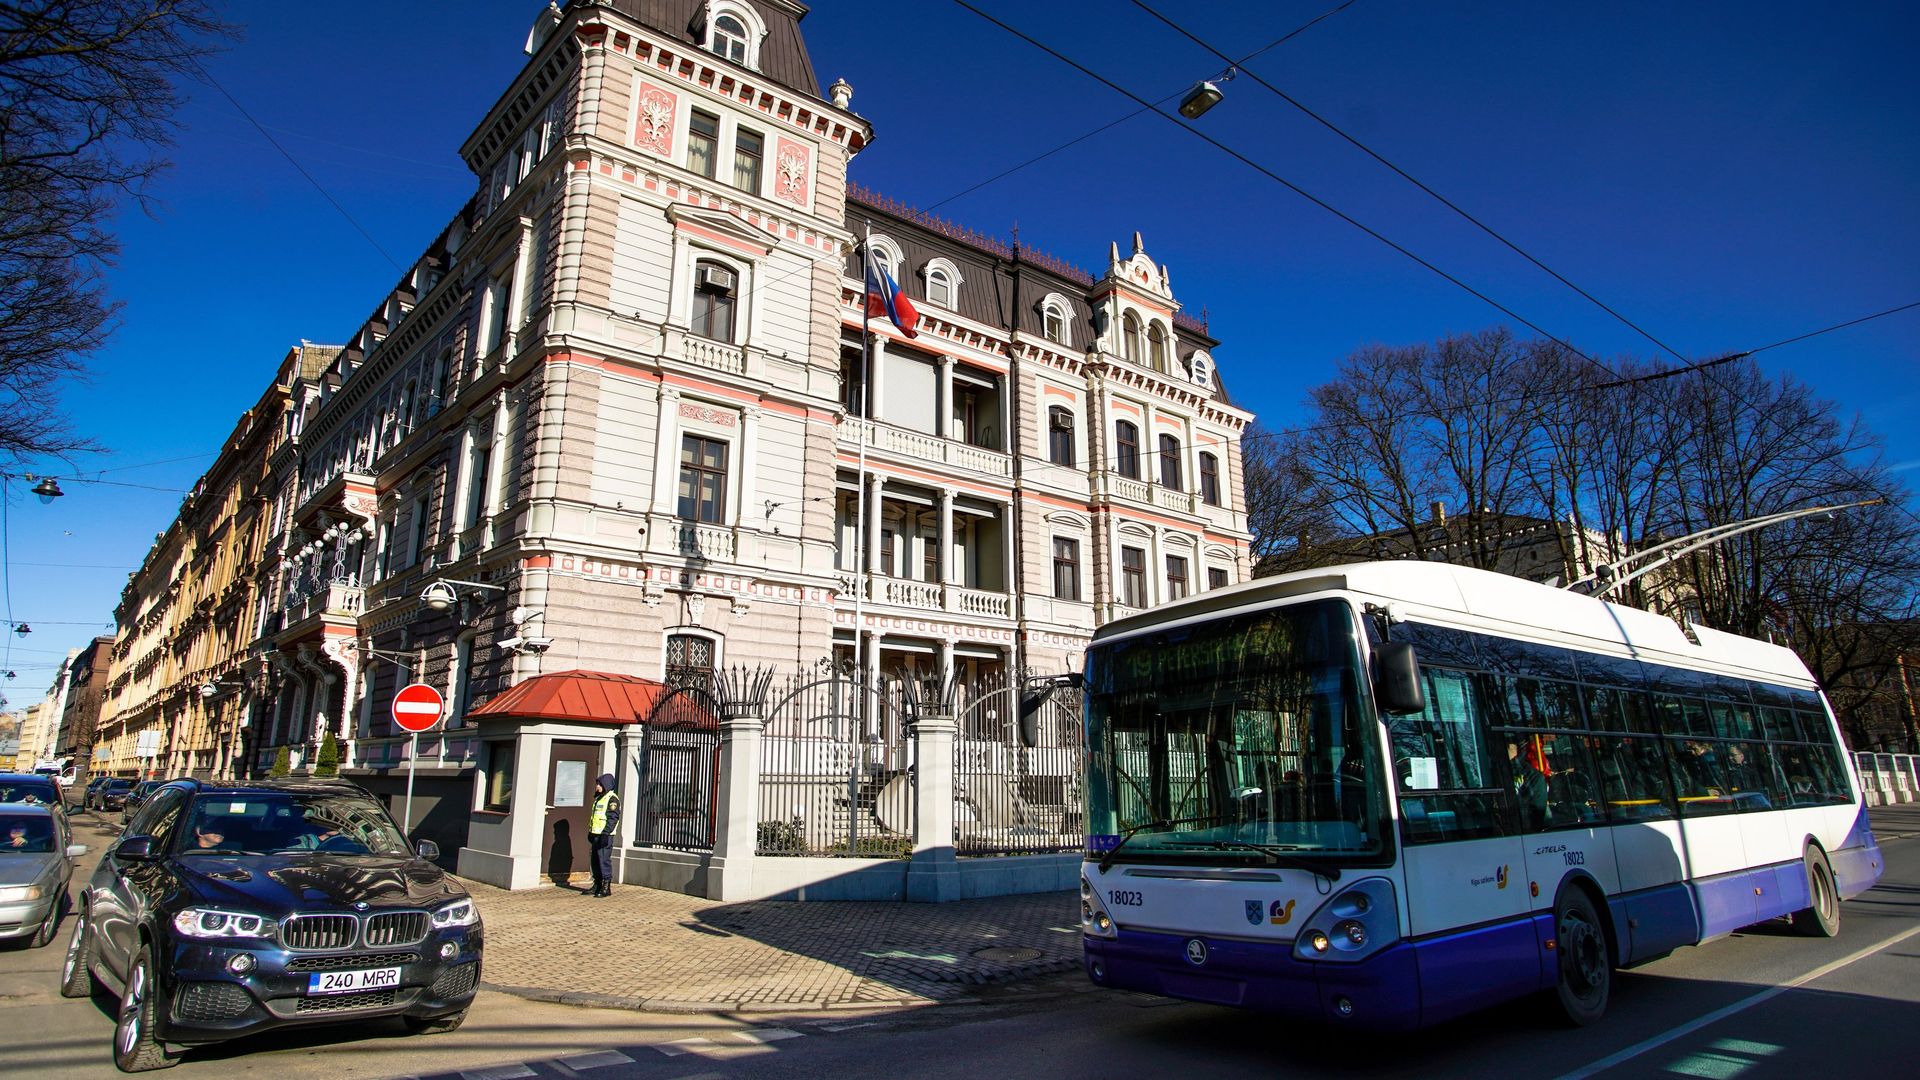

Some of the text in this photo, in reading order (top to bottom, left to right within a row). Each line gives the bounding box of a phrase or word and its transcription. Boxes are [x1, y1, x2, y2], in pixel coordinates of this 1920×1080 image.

[1563, 851, 1585, 866] 18023
[1108, 890, 1143, 906] 18023
[324, 970, 396, 989] 240 MRR
